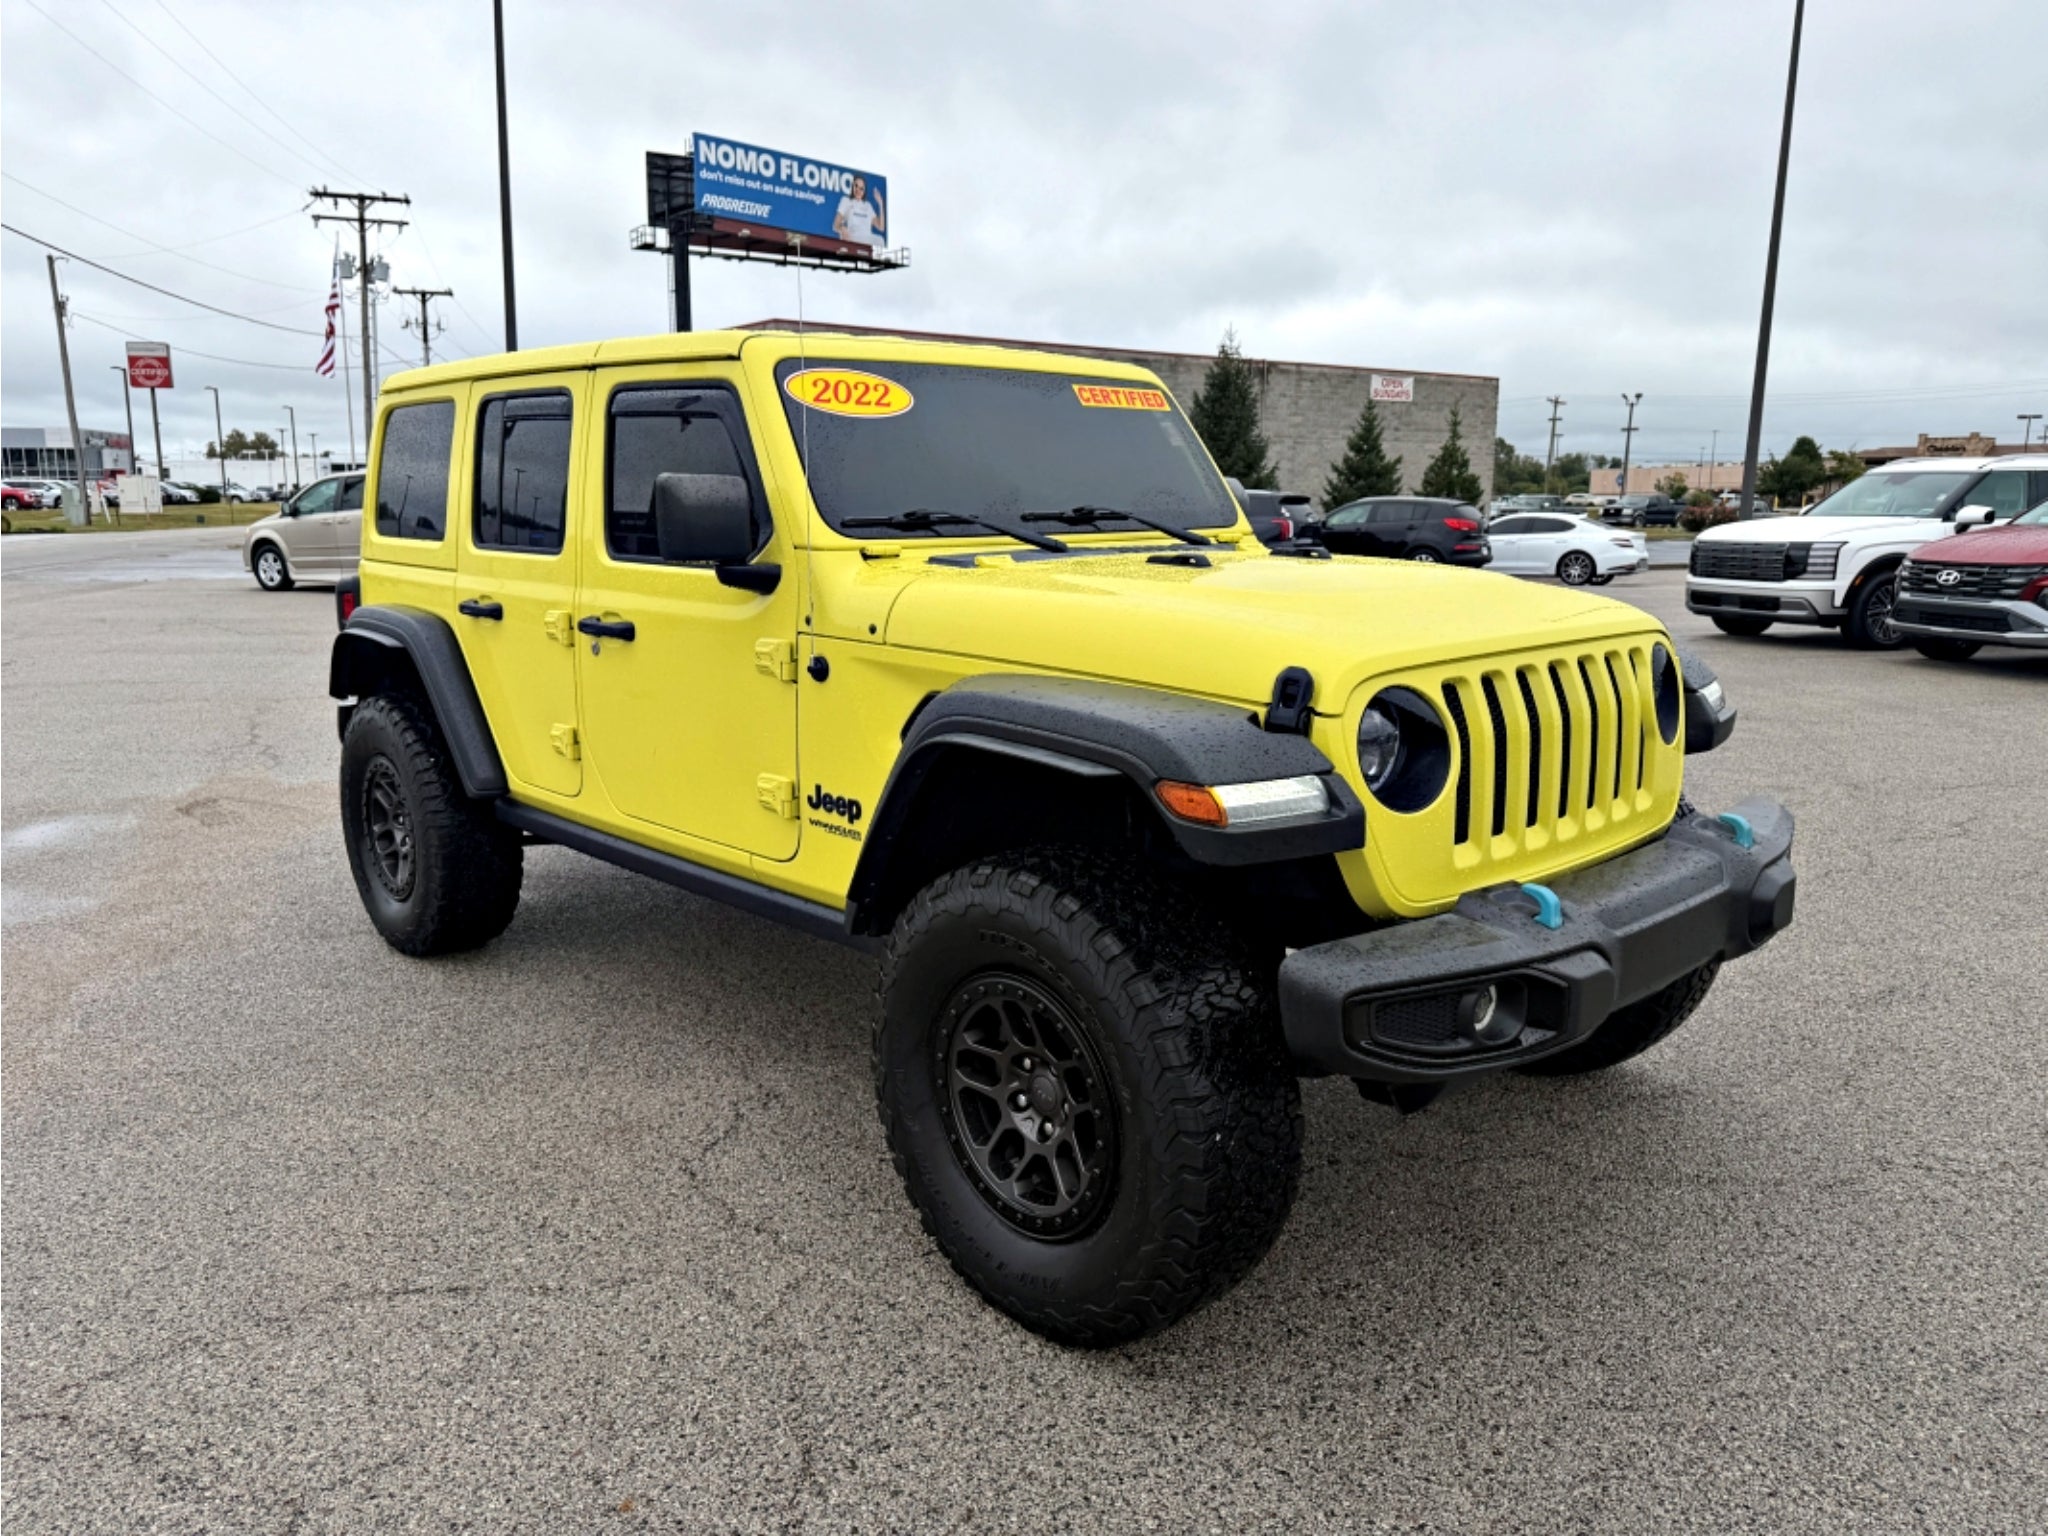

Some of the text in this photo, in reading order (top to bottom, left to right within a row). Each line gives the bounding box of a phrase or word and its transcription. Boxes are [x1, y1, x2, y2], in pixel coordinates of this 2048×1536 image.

[699, 140, 854, 196] NOMO FLOMO
[699, 168, 825, 206] don't miss out on auto savings
[701, 193, 772, 218] PROGRESSIVE
[811, 378, 892, 408] 2022
[1373, 388, 1411, 400] SUNDAYS
[1381, 377, 1404, 389] OPEN
[1077, 386, 1166, 408] CERTIFIED
[807, 784, 862, 825] Jeep
